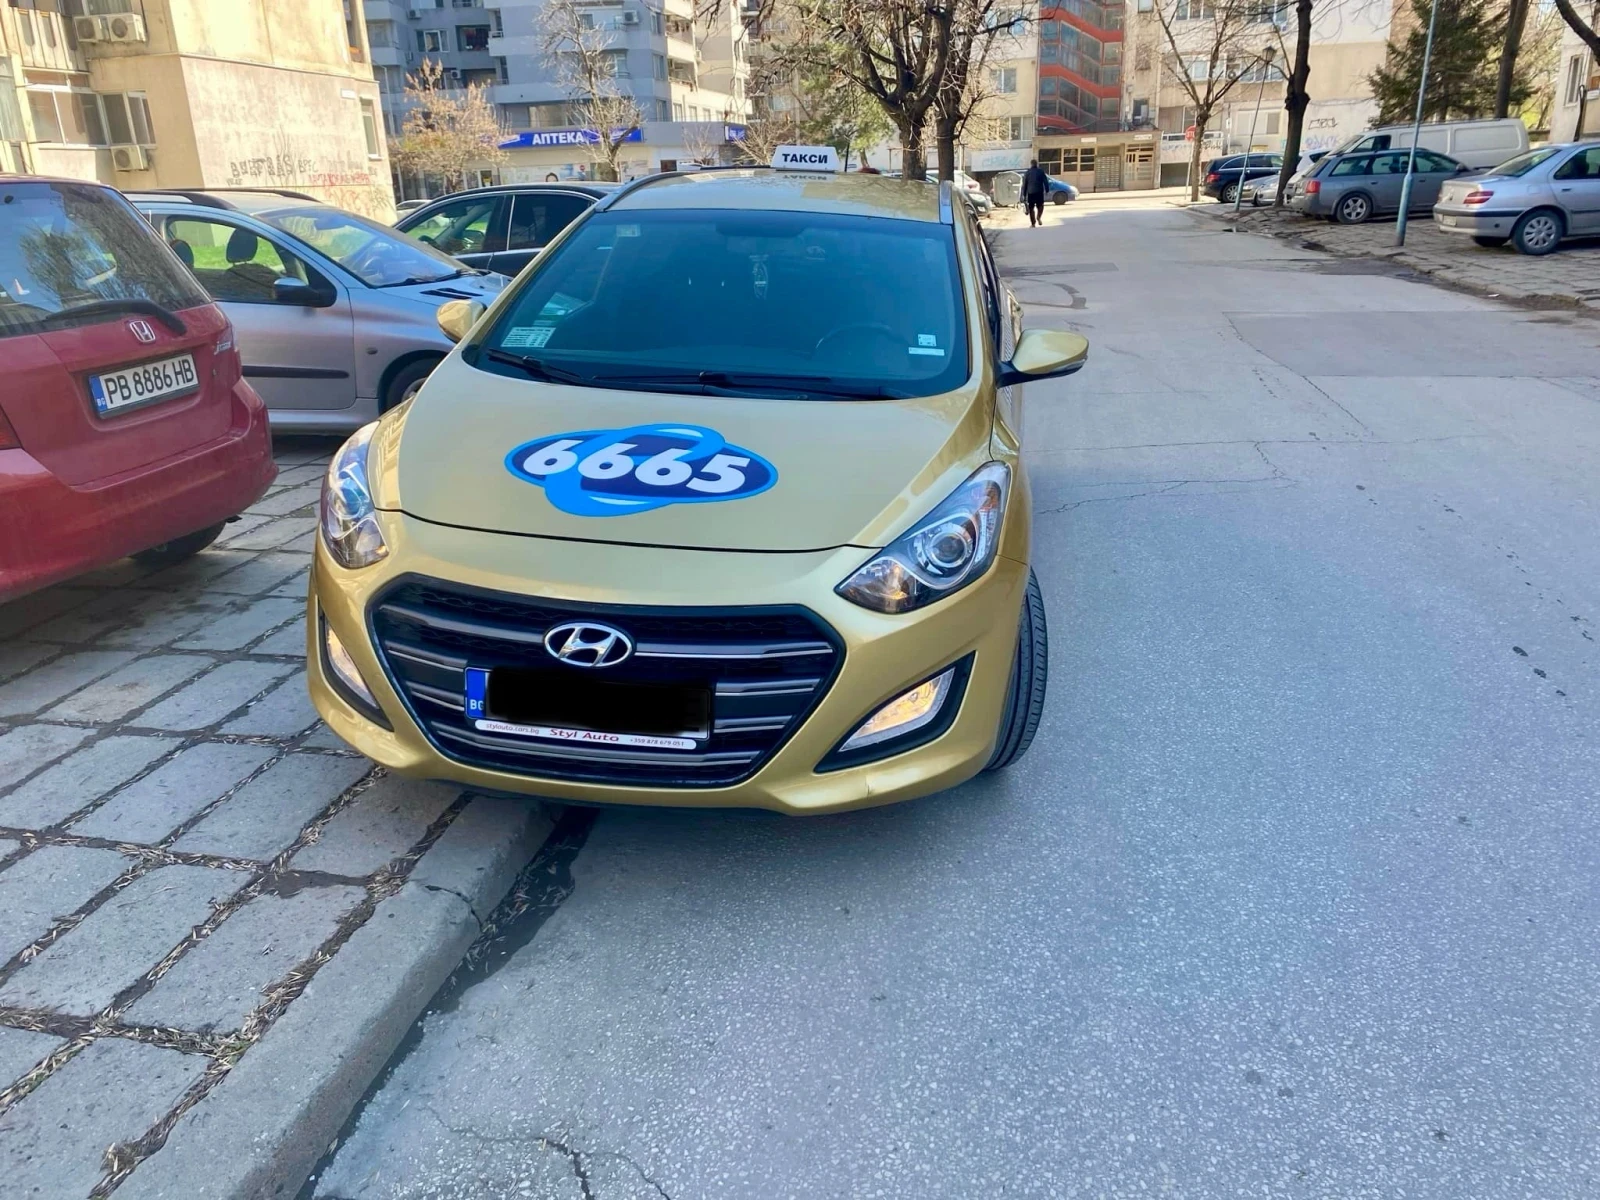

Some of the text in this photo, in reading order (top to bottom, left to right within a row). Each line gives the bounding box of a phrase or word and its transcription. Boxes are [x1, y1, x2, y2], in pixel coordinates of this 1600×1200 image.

[532, 131, 584, 146] АПТЕКА
[782, 153, 828, 164] ТАКСИ
[104, 358, 194, 404] PB 8886 HB
[523, 439, 750, 493] 6665
[486, 722, 540, 735] stylauto.cars.bg
[549, 728, 578, 739] Styl
[582, 732, 620, 742] Auto
